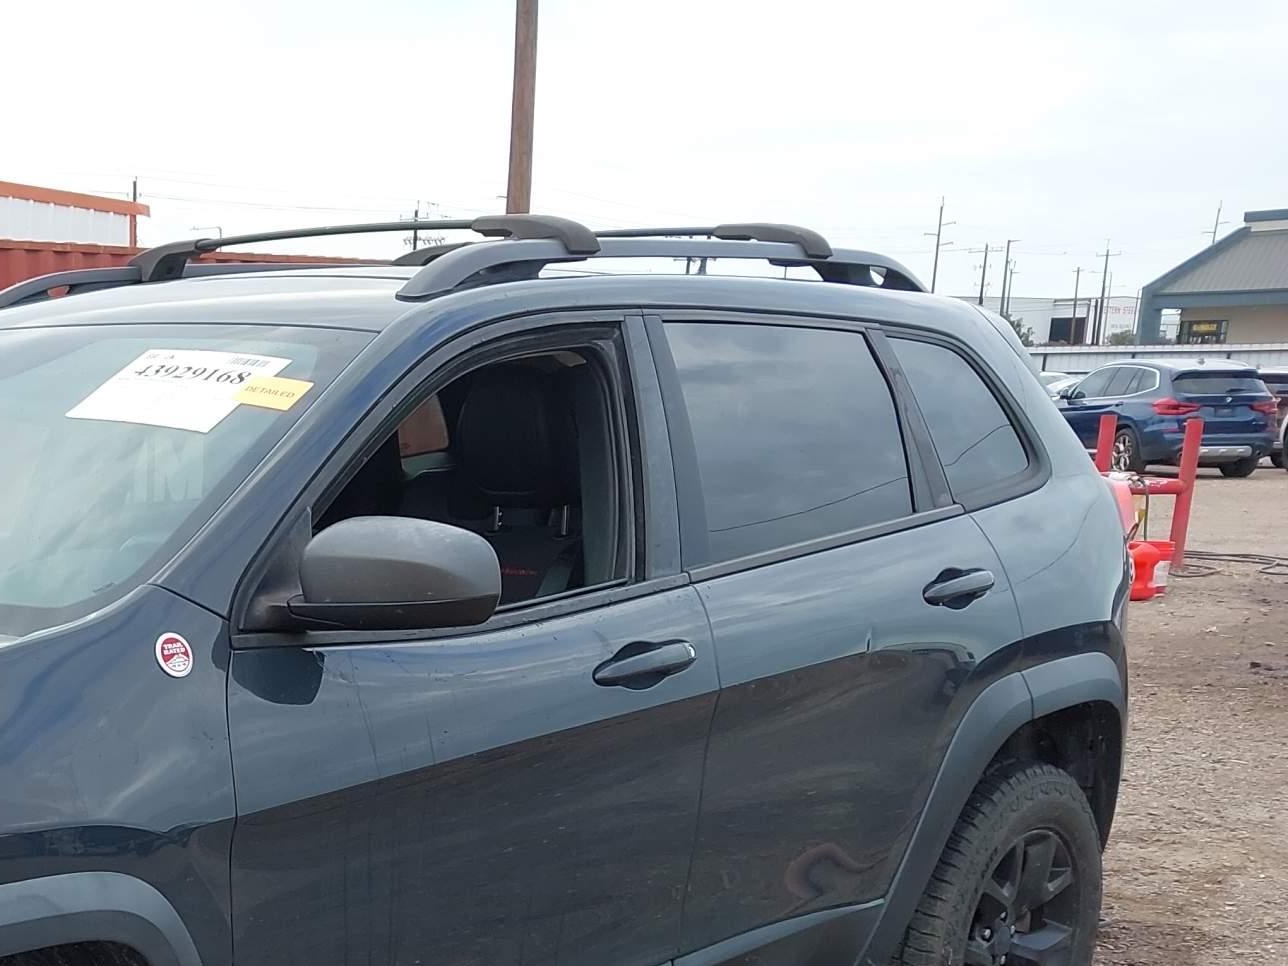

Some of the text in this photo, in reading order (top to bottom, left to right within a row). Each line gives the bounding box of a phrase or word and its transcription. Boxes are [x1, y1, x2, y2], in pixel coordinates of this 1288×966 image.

[133, 364, 253, 386] 43929168
[244, 385, 297, 400] DETAILED
[163, 641, 184, 650] TRAIL
[163, 647, 186, 655] RATED
